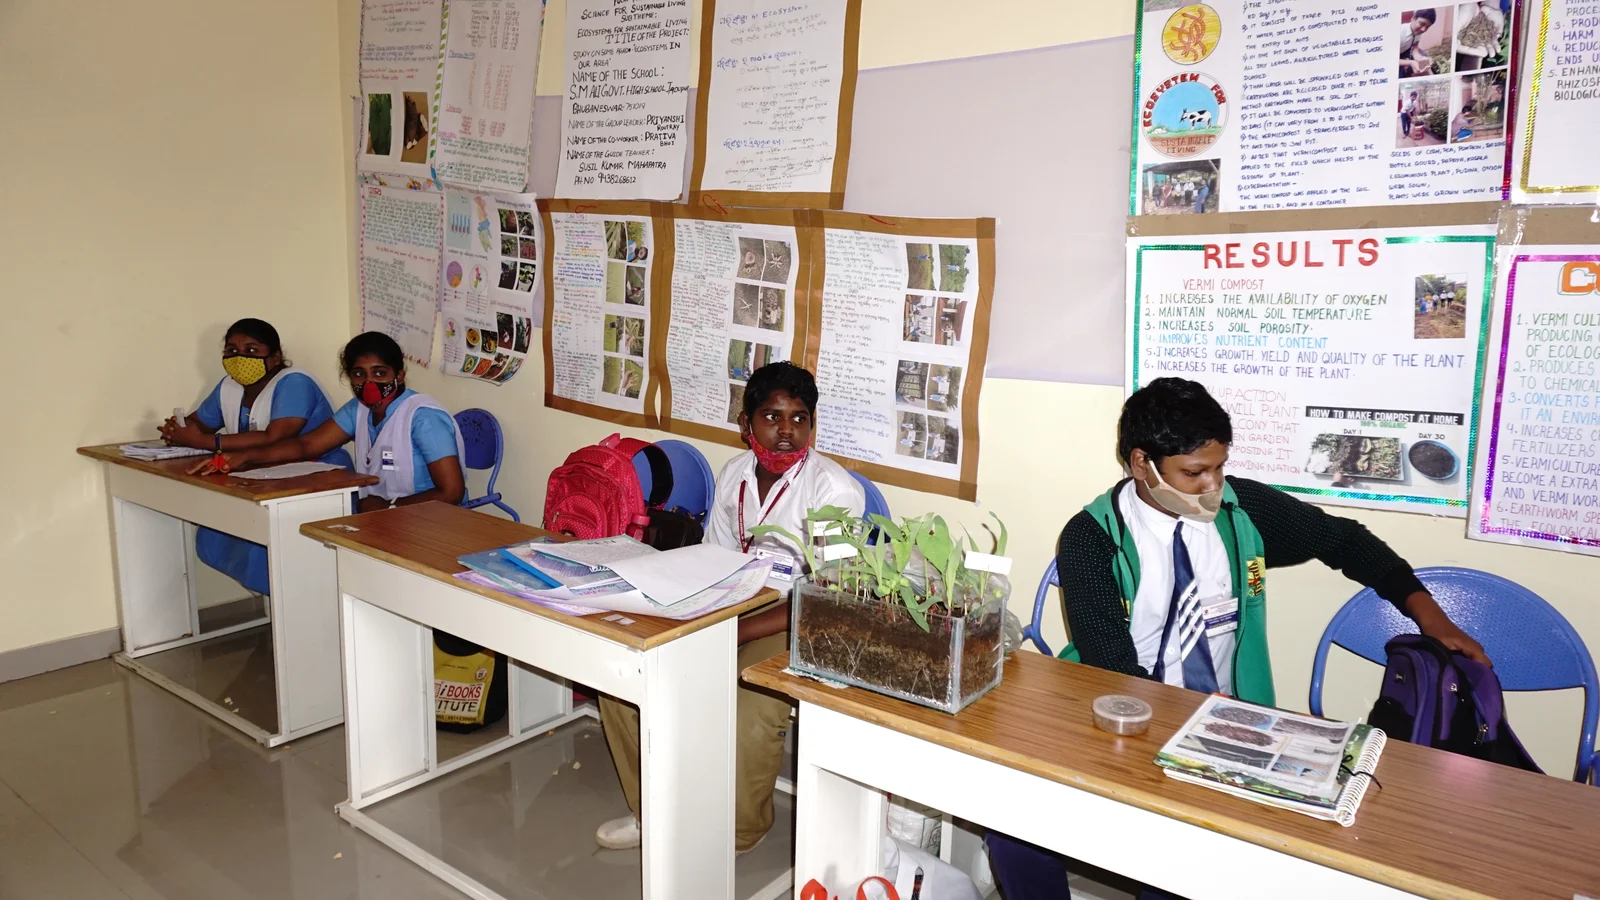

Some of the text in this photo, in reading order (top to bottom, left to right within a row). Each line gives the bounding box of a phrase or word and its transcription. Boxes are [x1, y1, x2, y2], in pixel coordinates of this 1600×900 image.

[614, 7, 627, 16] FOR
[1567, 6, 1600, 16] PROCE
[1563, 30, 1594, 41] HARM
[670, 42, 680, 50] IN
[1565, 42, 1600, 53] REDUC
[1557, 55, 1582, 65] ENDS
[573, 69, 627, 83] NAME OF THE
[1562, 65, 1600, 77] ENHAN
[601, 161, 624, 170] KUMAR
[1203, 238, 1379, 269] RESULTS
[1183, 279, 1264, 290] VERMI COMPOST
[1223, 295, 1242, 305] THE
[1249, 293, 1318, 305] AVAILABILITY
[1326, 294, 1339, 305] OF
[1343, 294, 1388, 305] OXYGEN
[1159, 306, 1205, 317] MAINTAIN
[1217, 308, 1257, 319] NORMAL
[1264, 308, 1286, 319] SOIL
[1293, 308, 1372, 320] TEMPERATURE
[1533, 313, 1568, 327] VERMI
[1159, 321, 1214, 332] INCREASES
[1228, 323, 1250, 333] SOIL
[1159, 334, 1328, 348] IMPROVES NUTRIENT CONTENT
[1527, 328, 1593, 342] PRODUCING
[1526, 345, 1542, 358] OF
[1261, 350, 1290, 363] YIELD
[1297, 352, 1318, 364] AND
[1322, 352, 1367, 365] QUALITY
[1373, 354, 1388, 366] OF
[1393, 354, 1419, 367] THE
[1158, 361, 1206, 372] INCREASES
[1212, 363, 1228, 374] THE
[1234, 364, 1273, 376] GROWTH
[1279, 366, 1291, 376] OF
[1296, 367, 1314, 378] THE
[1530, 360, 1595, 376] PRODUCES
[1520, 376, 1537, 389] TO
[1524, 393, 1589, 408] CONVERTS
[1226, 403, 1300, 419] WILL PLANT
[1310, 409, 1458, 425] HOW TO MAKE COMPOST AT HOME
[1521, 408, 1600, 425] IT AN ENVIR
[1271, 421, 1300, 433] THAT
[1522, 425, 1583, 441] INCREASES
[1249, 434, 1289, 444] GARDEN
[1276, 448, 1294, 460] IT
[1512, 439, 1595, 458] FERTILIZERS
[1268, 464, 1300, 474] NATION
[1502, 471, 1598, 491] BECOME A EXTRA
[1504, 488, 1525, 500] AND
[1533, 490, 1569, 505] VERMI
[1511, 503, 1578, 521] EARTHWORM
[1501, 518, 1599, 539] THE ECOLOGICAL
[447, 686, 482, 698] BOOKS
[438, 700, 477, 712] ITUTE
